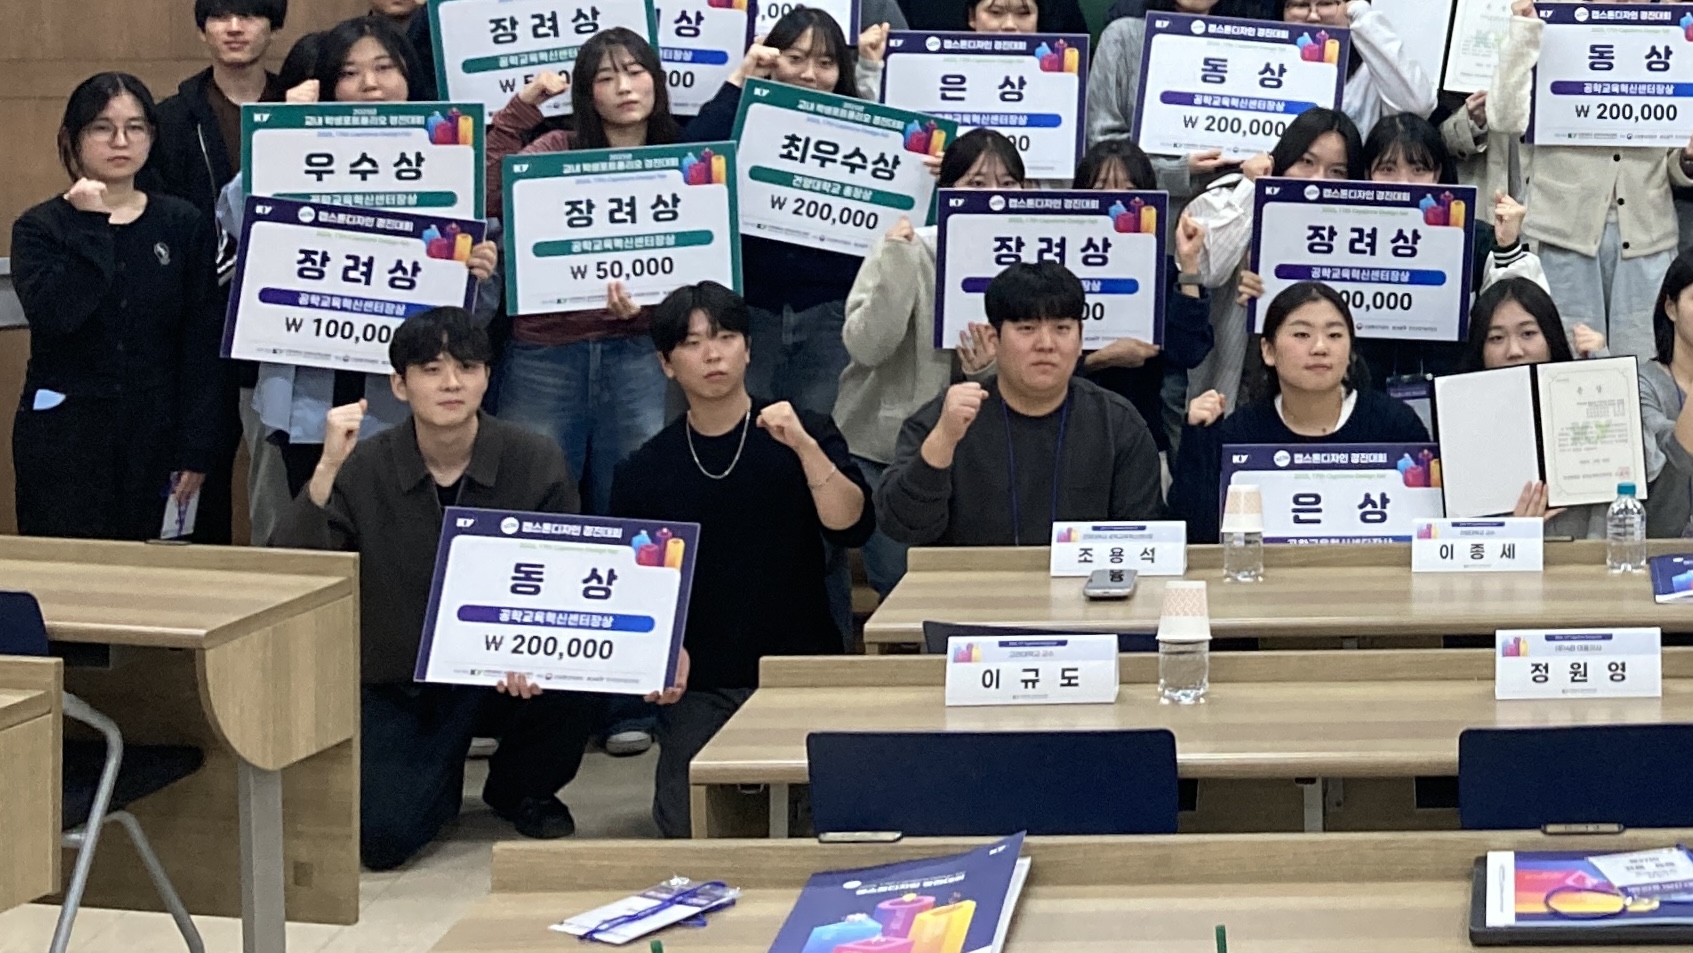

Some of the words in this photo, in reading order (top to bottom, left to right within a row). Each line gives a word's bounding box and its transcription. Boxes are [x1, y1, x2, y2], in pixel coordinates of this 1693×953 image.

[1597, 103, 1678, 122] 200,000
[1204, 116, 1287, 138] 200,000
[779, 133, 901, 181] 최우수상
[792, 198, 879, 230] 200,000
[596, 257, 674, 280] 50,000
[312, 318, 396, 344] 100,00
[511, 634, 614, 660] 200,000
